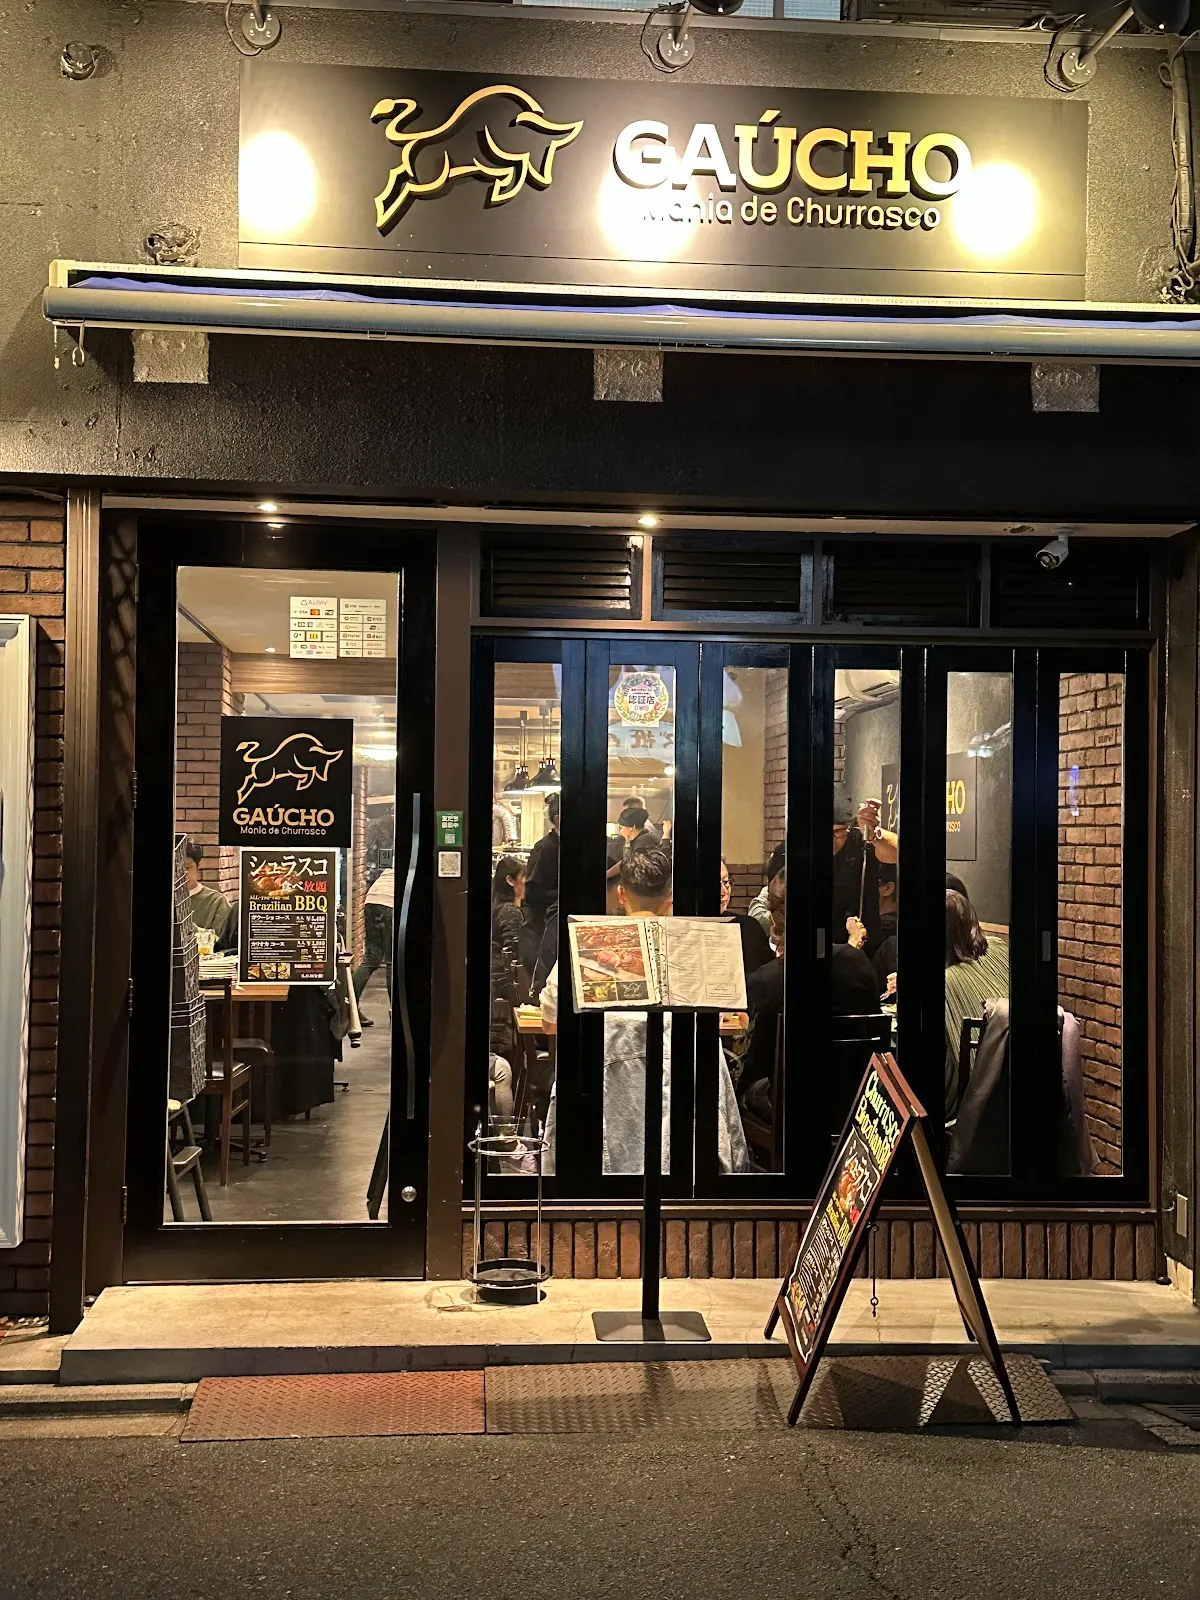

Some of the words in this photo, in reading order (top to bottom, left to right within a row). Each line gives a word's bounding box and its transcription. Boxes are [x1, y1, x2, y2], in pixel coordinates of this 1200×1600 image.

[613, 110, 973, 201] GAÚCHO
[741, 195, 777, 224] de
[786, 197, 941, 231] Churrasco
[232, 803, 335, 827] GAÚCHO
[240, 826, 267, 835] Mania
[268, 826, 280, 835] de
[281, 826, 327, 836] Churrasco
[249, 855, 328, 878] シュラスコ
[249, 900, 293, 911] Brazilian
[294, 895, 328, 913] BBQ
[844, 1139, 873, 1205] シュラスコ
